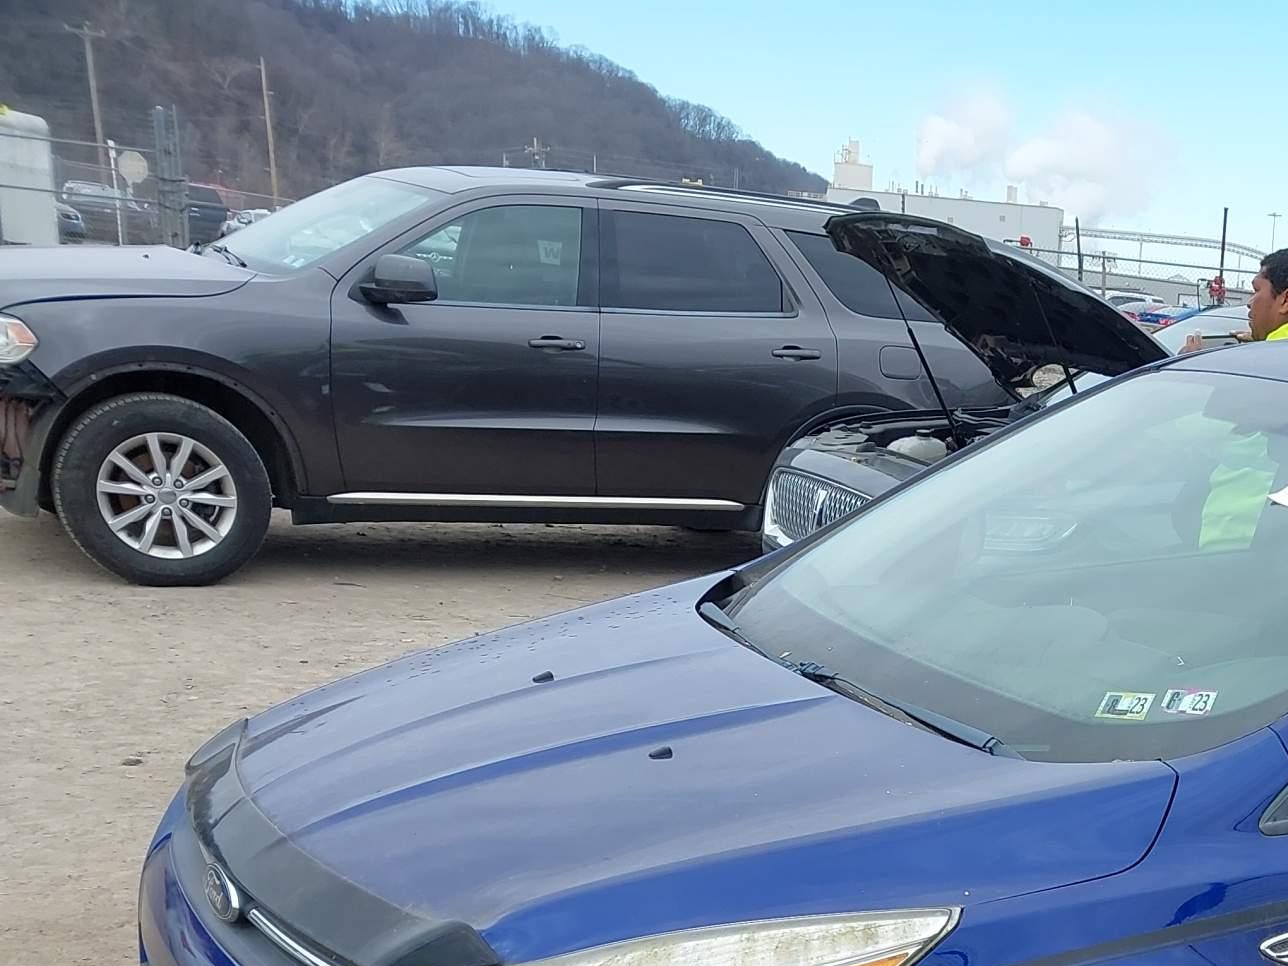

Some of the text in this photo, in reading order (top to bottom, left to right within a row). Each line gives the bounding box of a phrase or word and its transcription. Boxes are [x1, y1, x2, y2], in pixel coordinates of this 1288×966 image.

[1129, 696, 1148, 715] 23
[1191, 693, 1210, 712] 23
[206, 870, 224, 911] Ford
